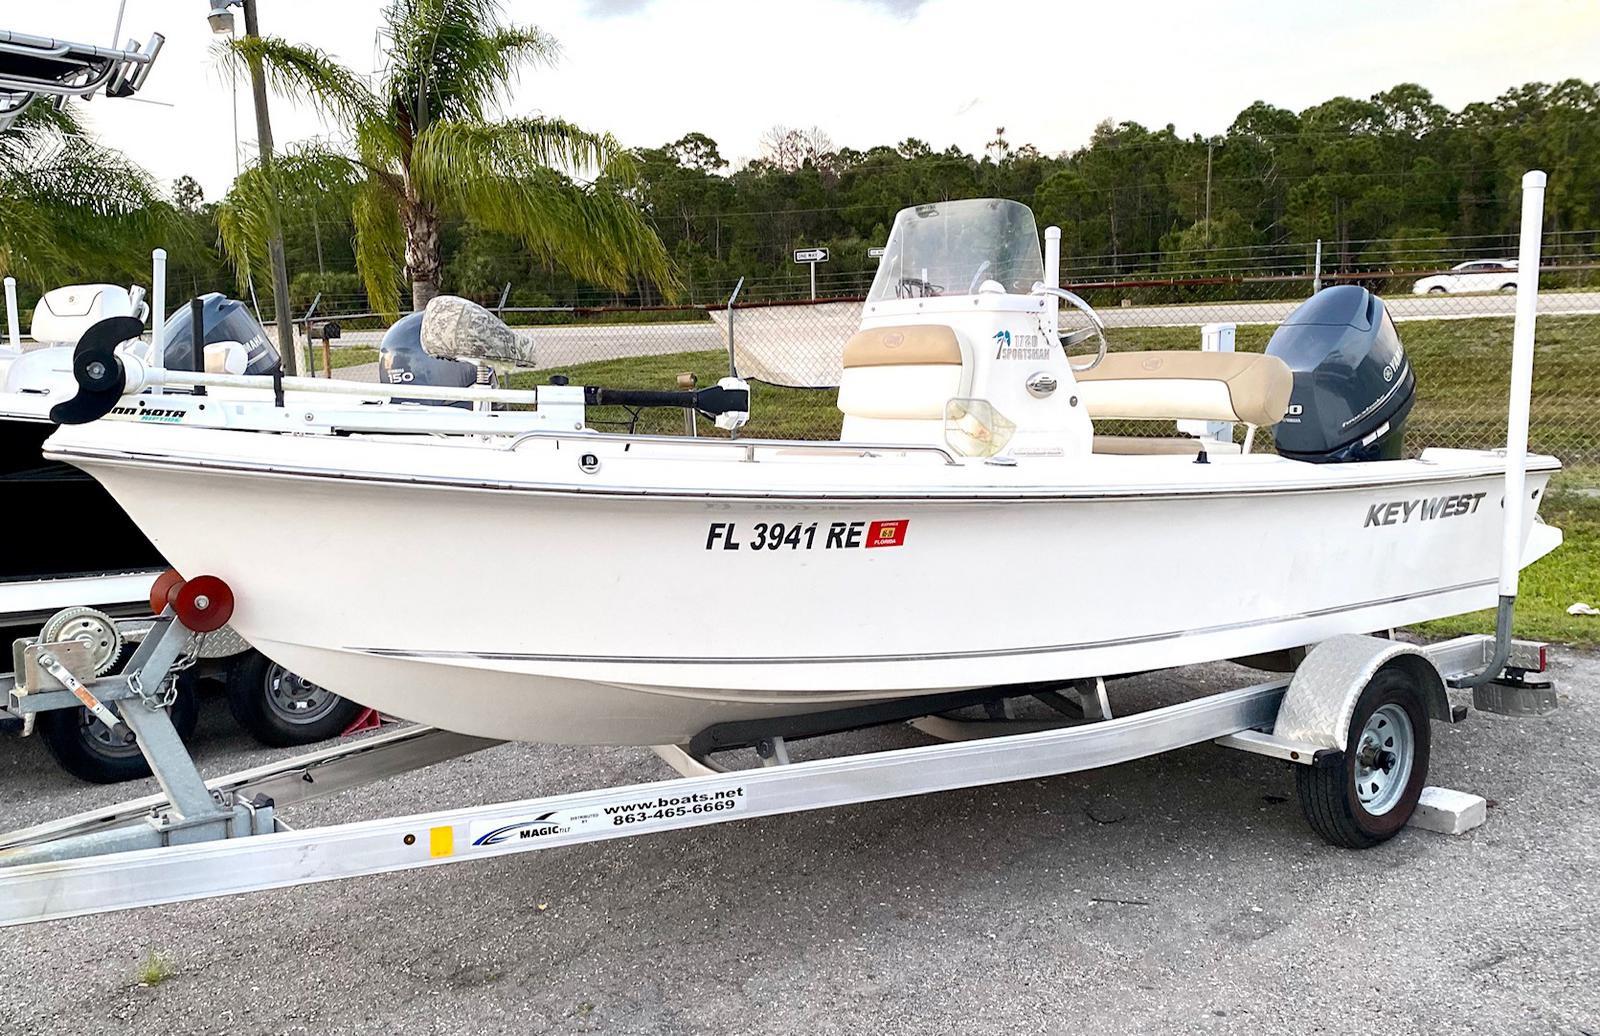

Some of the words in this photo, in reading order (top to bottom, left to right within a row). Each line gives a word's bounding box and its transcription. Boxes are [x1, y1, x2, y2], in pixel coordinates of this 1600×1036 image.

[1002, 348, 1050, 360] SPORTSMAN
[387, 371, 414, 383] 150
[139, 408, 186, 418] KOTA
[706, 523, 740, 550] FL
[750, 522, 818, 551] 3941
[826, 521, 866, 549] RE
[604, 787, 744, 815] www.boats.net
[570, 813, 599, 821] DISTRIBUTED
[613, 800, 735, 826] 863-465-6669
